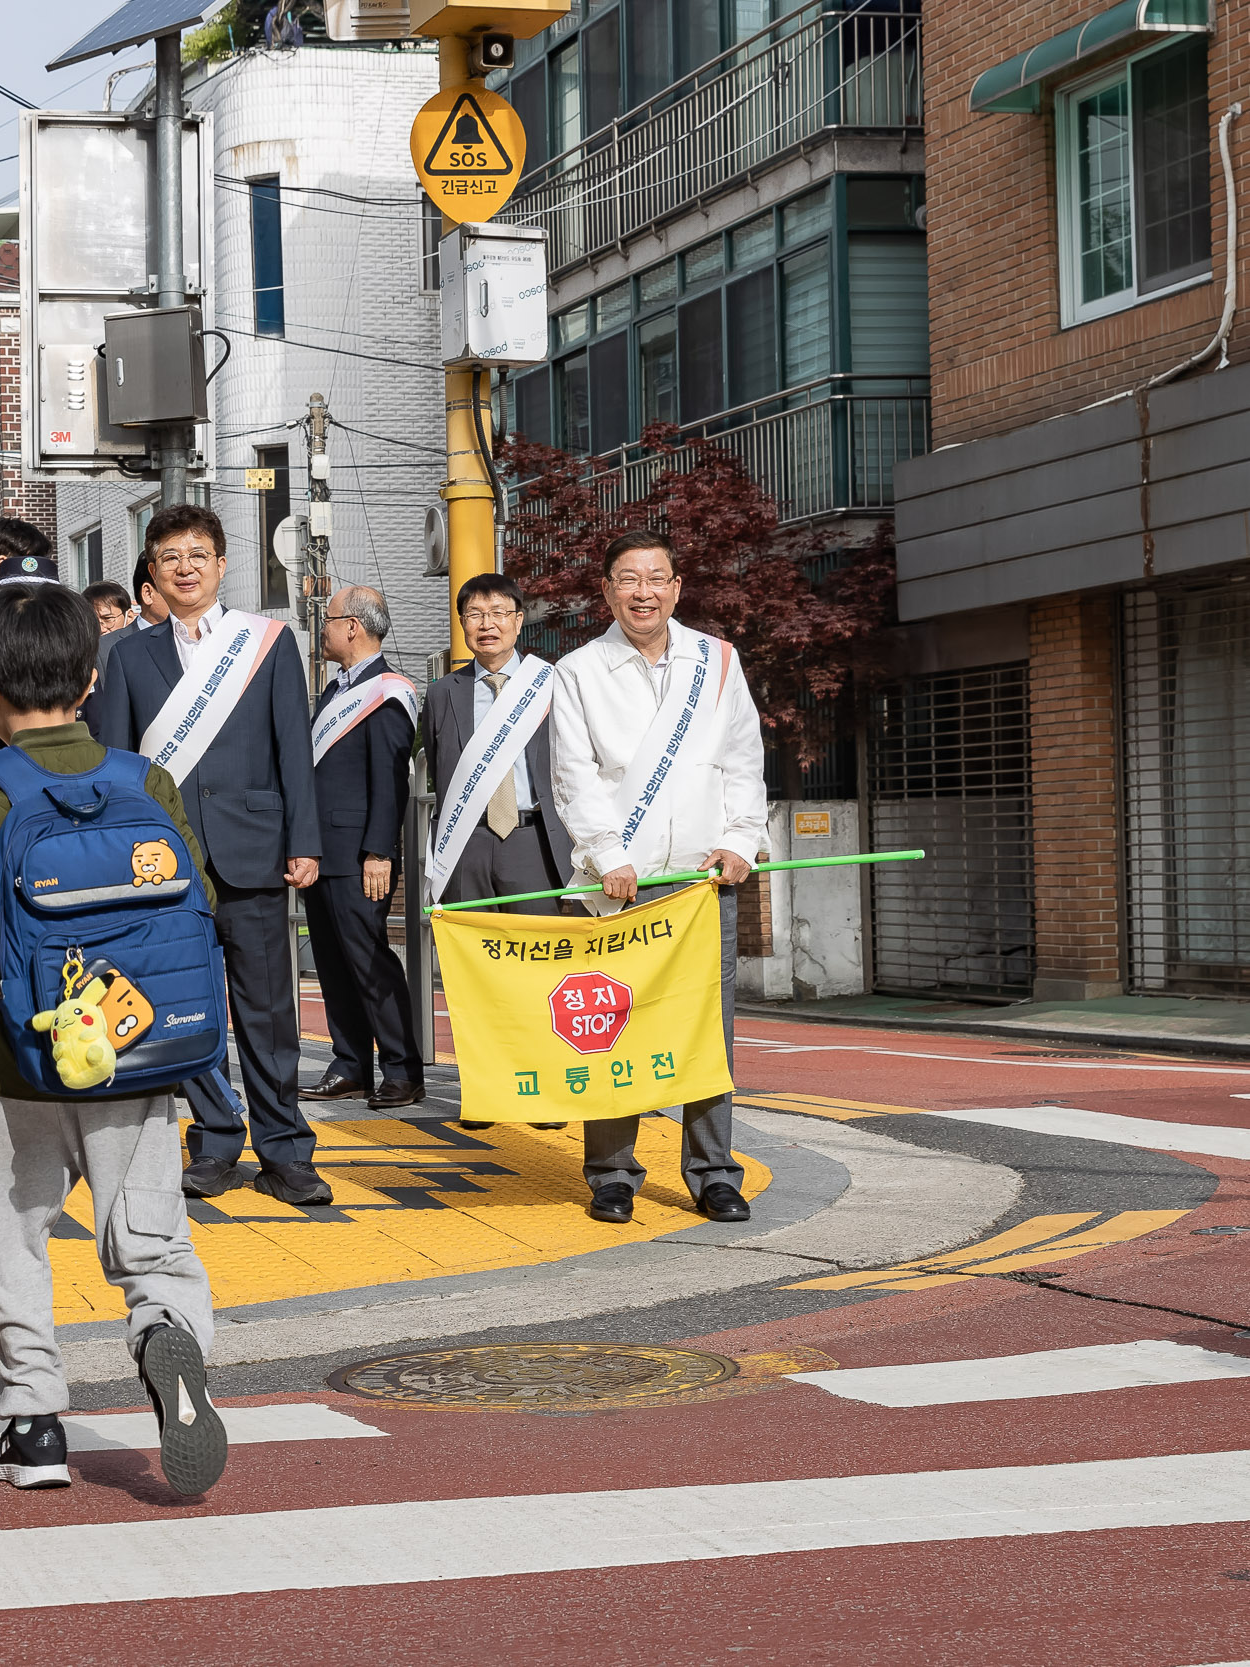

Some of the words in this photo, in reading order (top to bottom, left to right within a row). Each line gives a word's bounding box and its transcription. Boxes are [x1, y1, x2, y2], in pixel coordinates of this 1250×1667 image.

[449, 152, 488, 167] SOS
[441, 180, 498, 195] 긴급신고
[50, 431, 71, 442] 3M
[227, 628, 251, 658] 소중한
[201, 656, 234, 698] 아이들의
[532, 664, 553, 691] 소중한
[687, 666, 707, 708] 아이들의
[172, 695, 209, 744] 등하굣길
[507, 687, 538, 726] 아이들의
[481, 723, 511, 765] 등하굣길
[668, 707, 694, 758] 등하굣길
[151, 741, 179, 767] 안전
[458, 763, 488, 804] 안전하게
[638, 756, 673, 806] 안전하게
[437, 803, 464, 855] 지켜주세요
[621, 806, 647, 851] 지켜주
[34, 878, 59, 889] RYAN
[481, 938, 574, 962] 정지선을
[584, 918, 673, 957] 지킵시다
[75, 971, 94, 990] RYAN
[163, 1012, 206, 1028] Sammies
[570, 1012, 617, 1038] STOP
